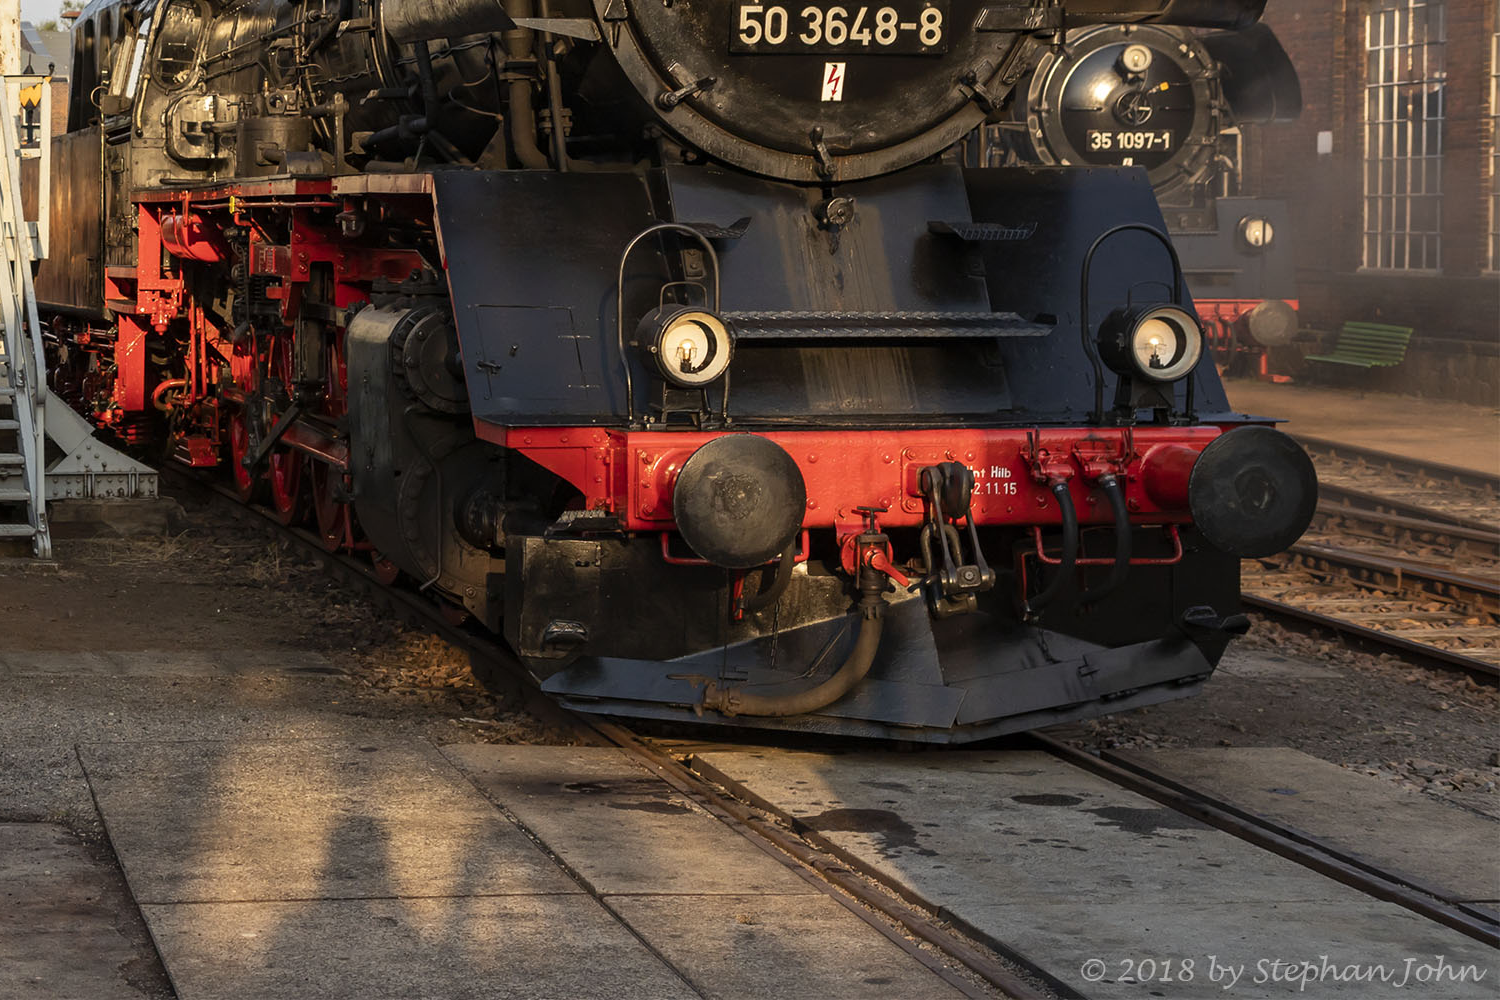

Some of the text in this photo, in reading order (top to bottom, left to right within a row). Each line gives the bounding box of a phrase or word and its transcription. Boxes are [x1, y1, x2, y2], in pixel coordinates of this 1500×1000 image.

[739, 5, 943, 46] 50 3648-8
[1091, 132, 1170, 149] 35 1097-1
[990, 465, 1012, 479] Hilb
[971, 482, 1017, 495] 2.11.15
